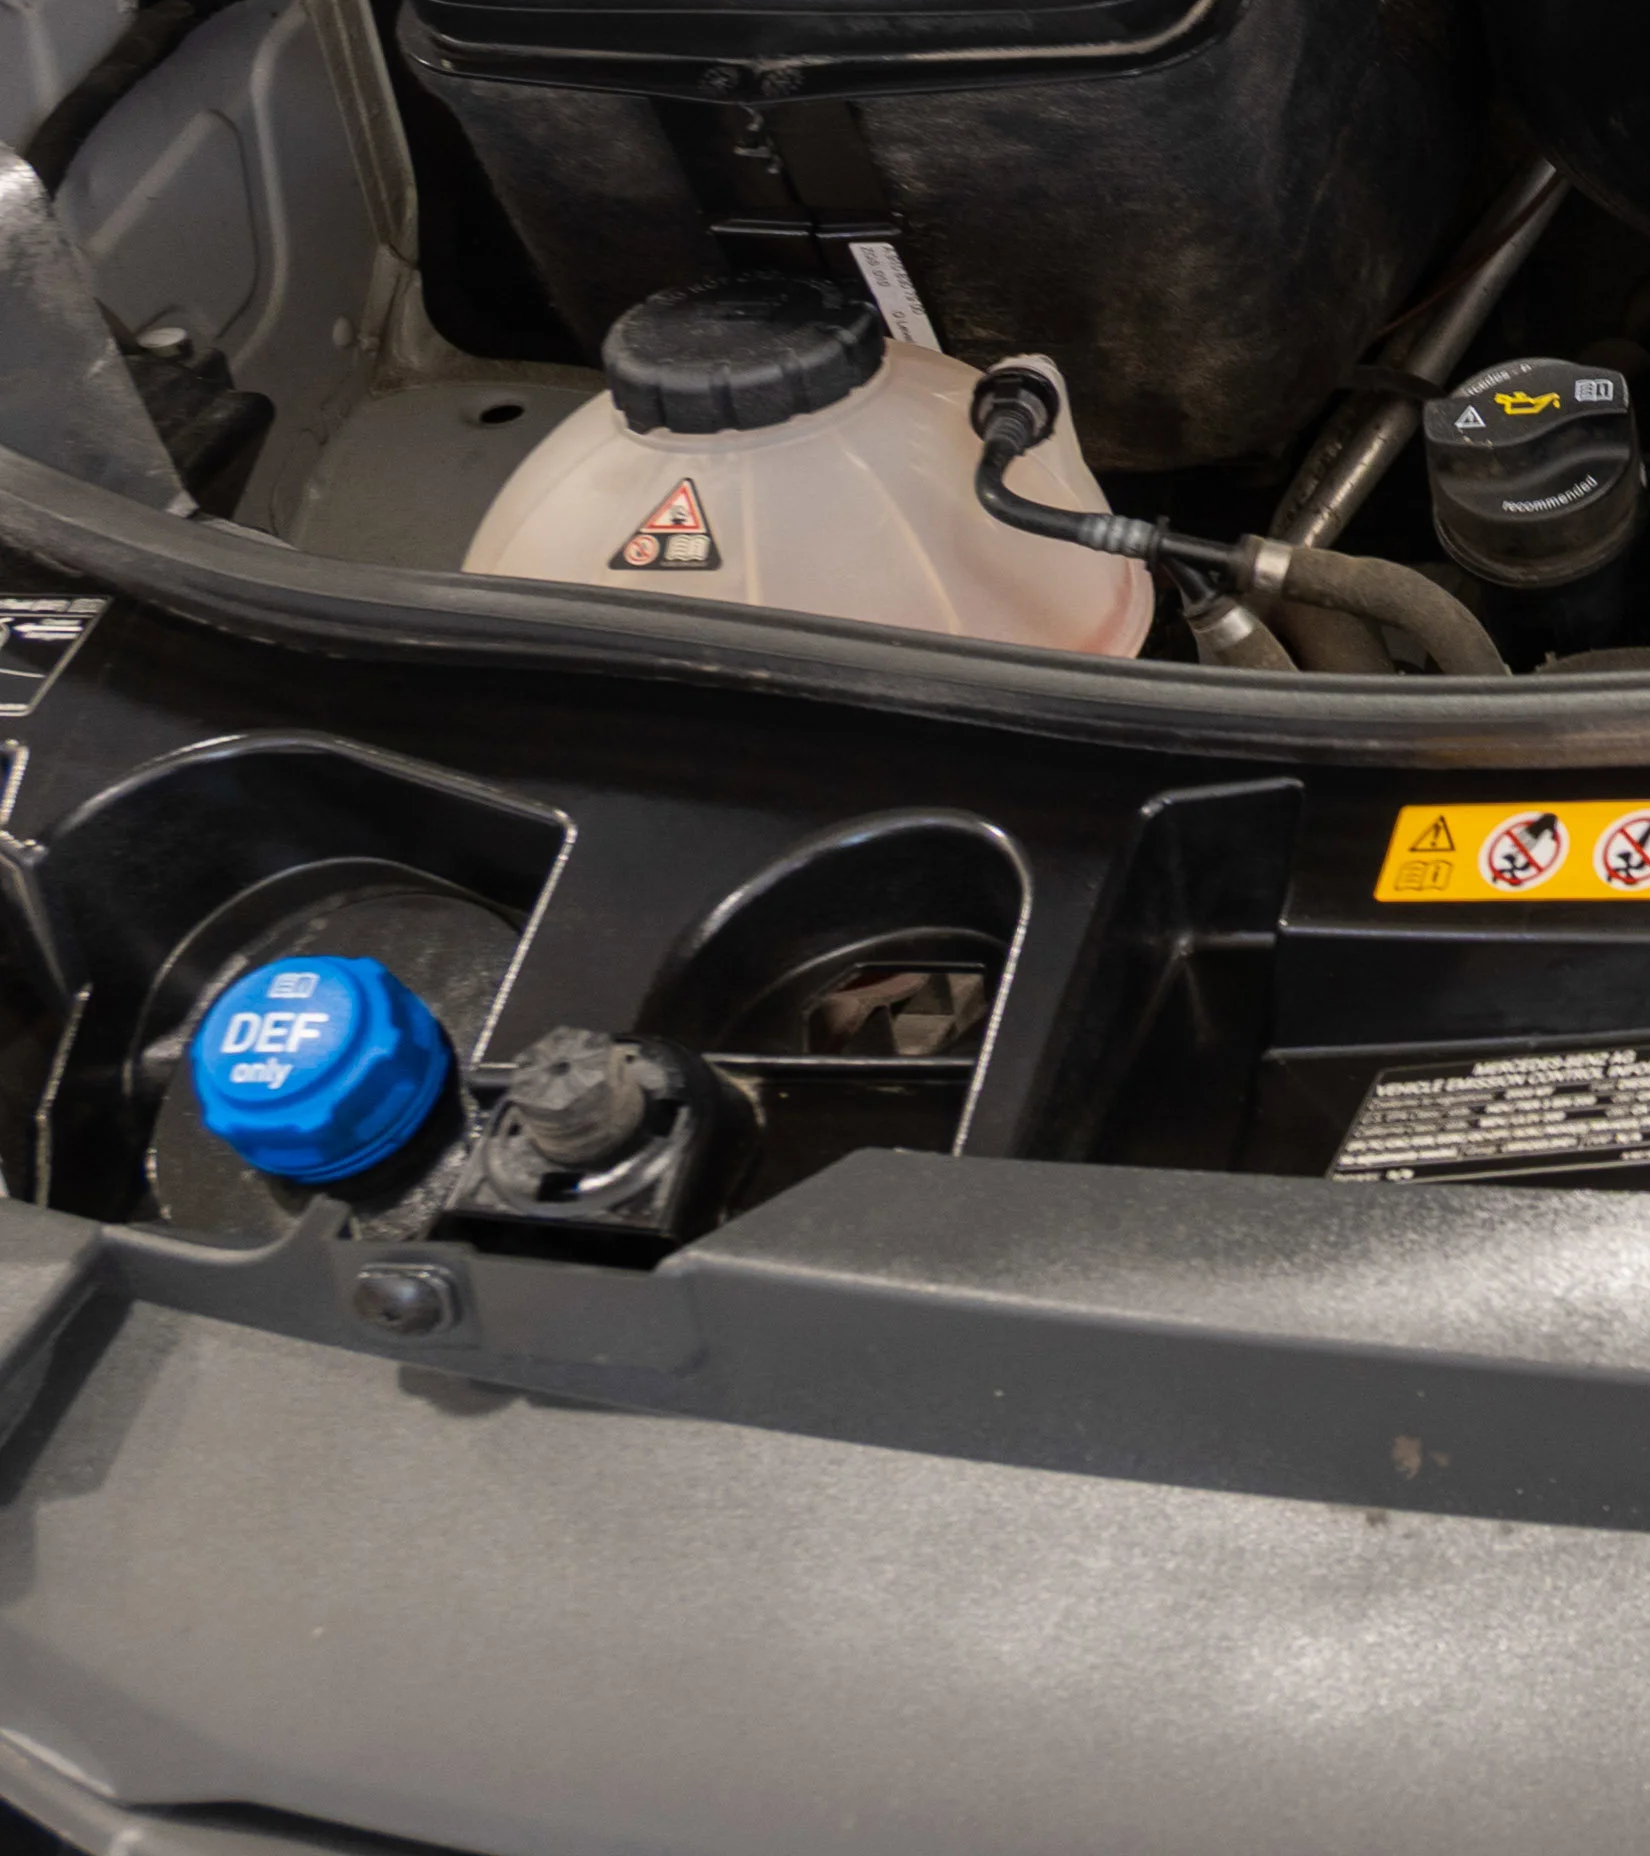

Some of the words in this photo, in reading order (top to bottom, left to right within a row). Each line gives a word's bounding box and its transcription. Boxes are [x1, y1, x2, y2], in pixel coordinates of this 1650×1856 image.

[1502, 474, 1599, 513] recommended
[220, 1012, 330, 1054] DEF
[229, 1057, 294, 1090] only
[1376, 1078, 1445, 1098] VEHICLE
[1444, 1074, 1527, 1093] EMISSION
[1526, 1067, 1604, 1085] CONTROL
